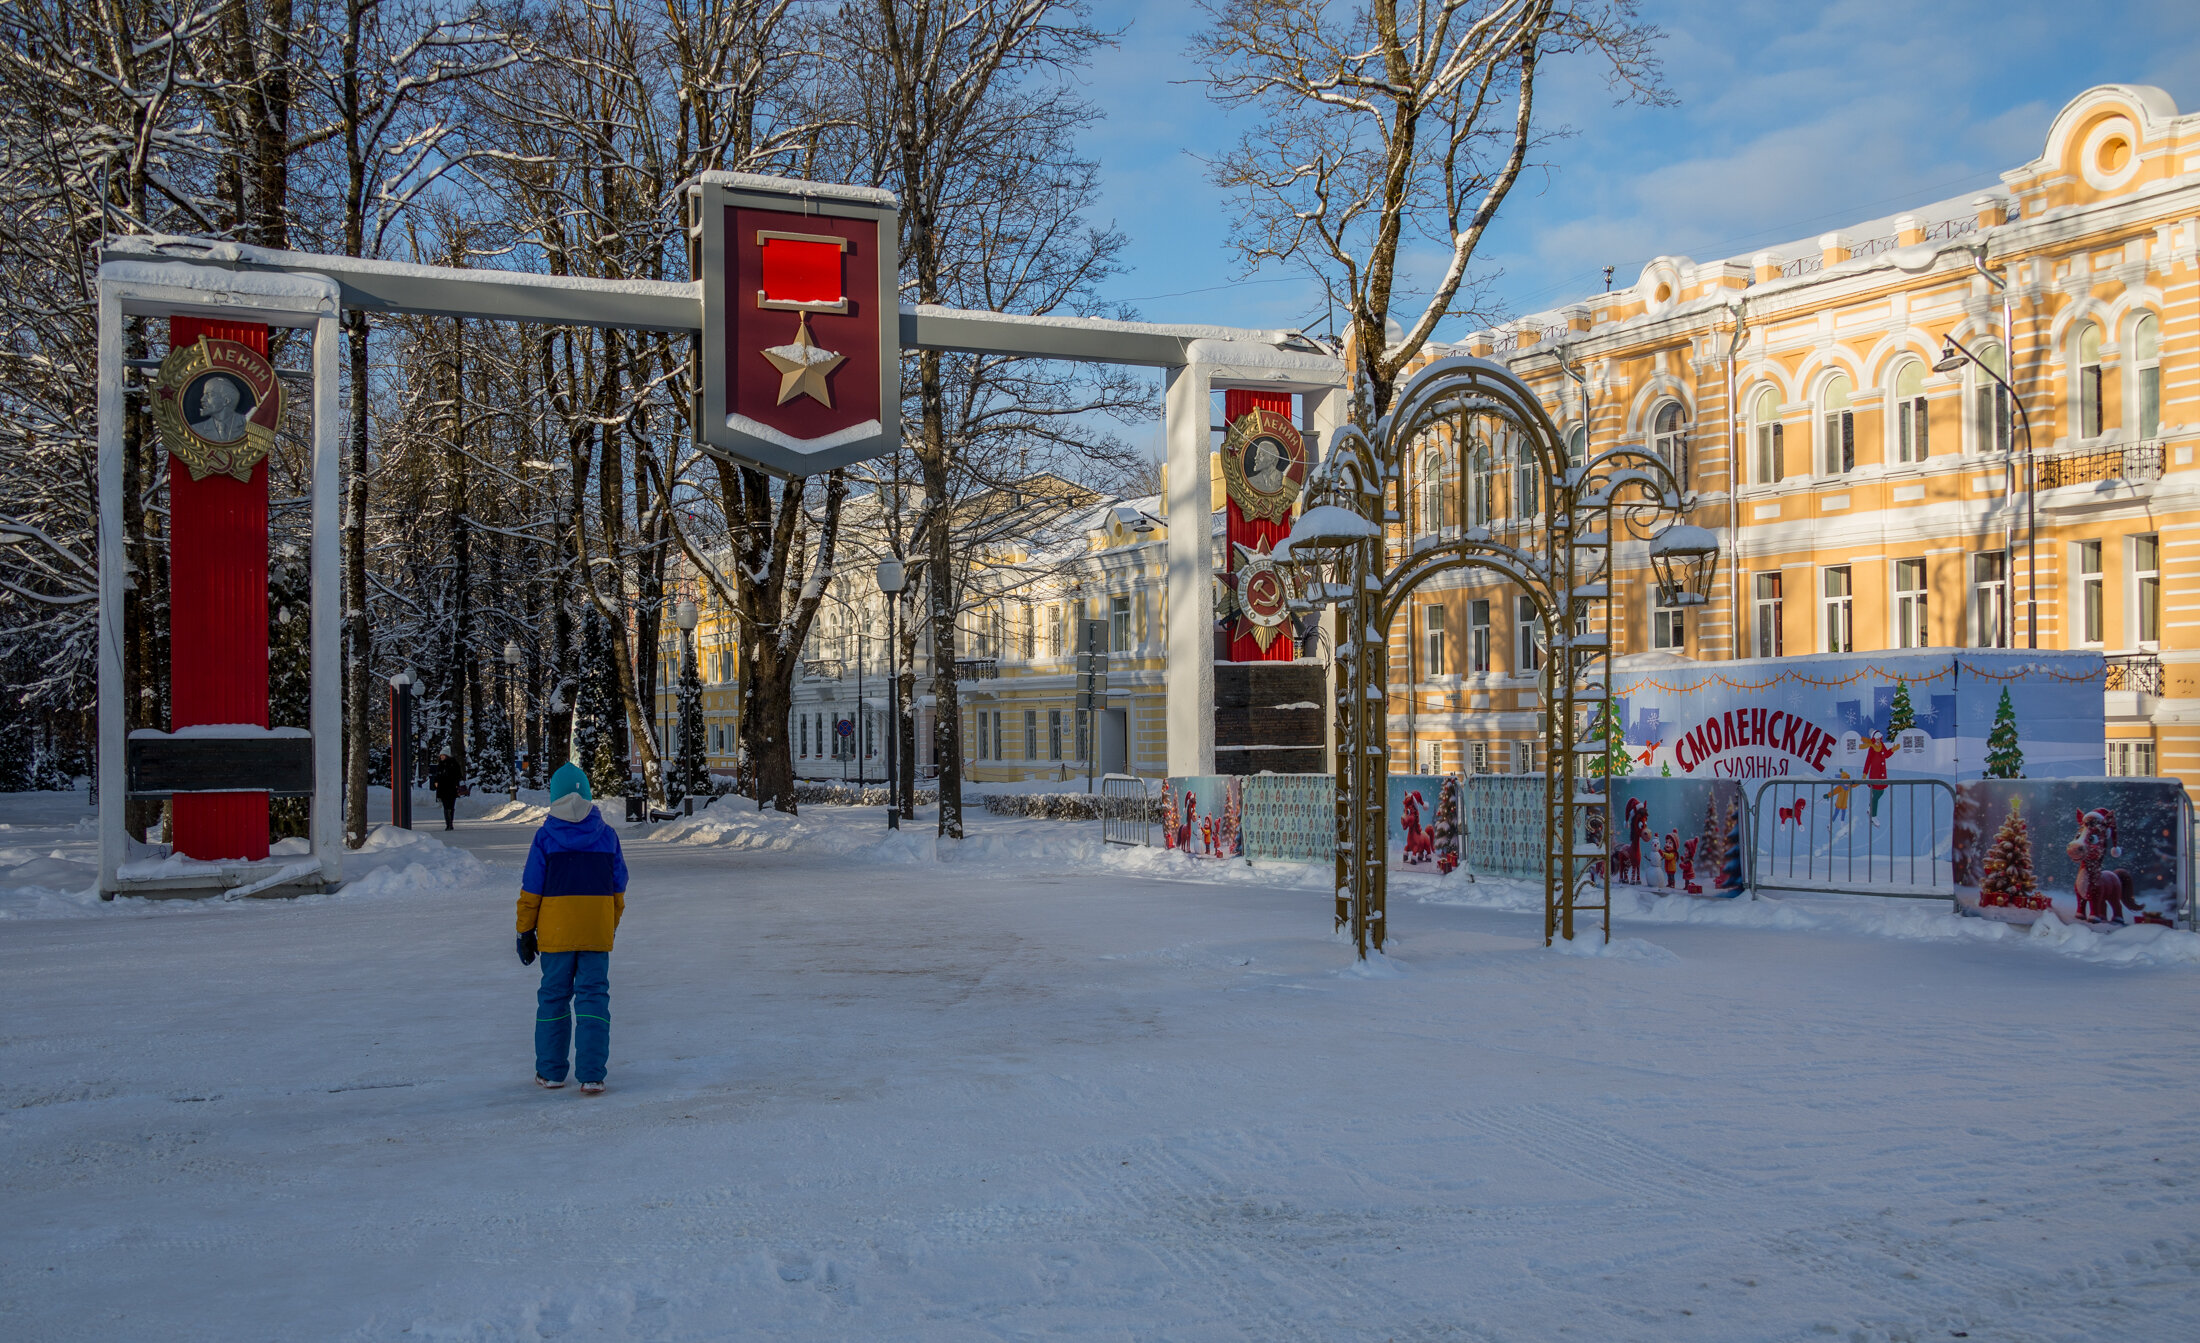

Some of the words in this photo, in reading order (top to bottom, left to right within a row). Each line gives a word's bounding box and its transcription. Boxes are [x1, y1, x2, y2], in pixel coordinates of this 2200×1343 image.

[212, 347, 270, 383] ЛЕНИН
[1263, 416, 1299, 446] ЛЕНИН
[1238, 560, 1288, 620] ОТЕЧЕСТВЕН
[1675, 707, 1838, 773] СМОЛЕНСКИЕ
[1713, 755, 1790, 779] ГУЛЯНЬЯ
